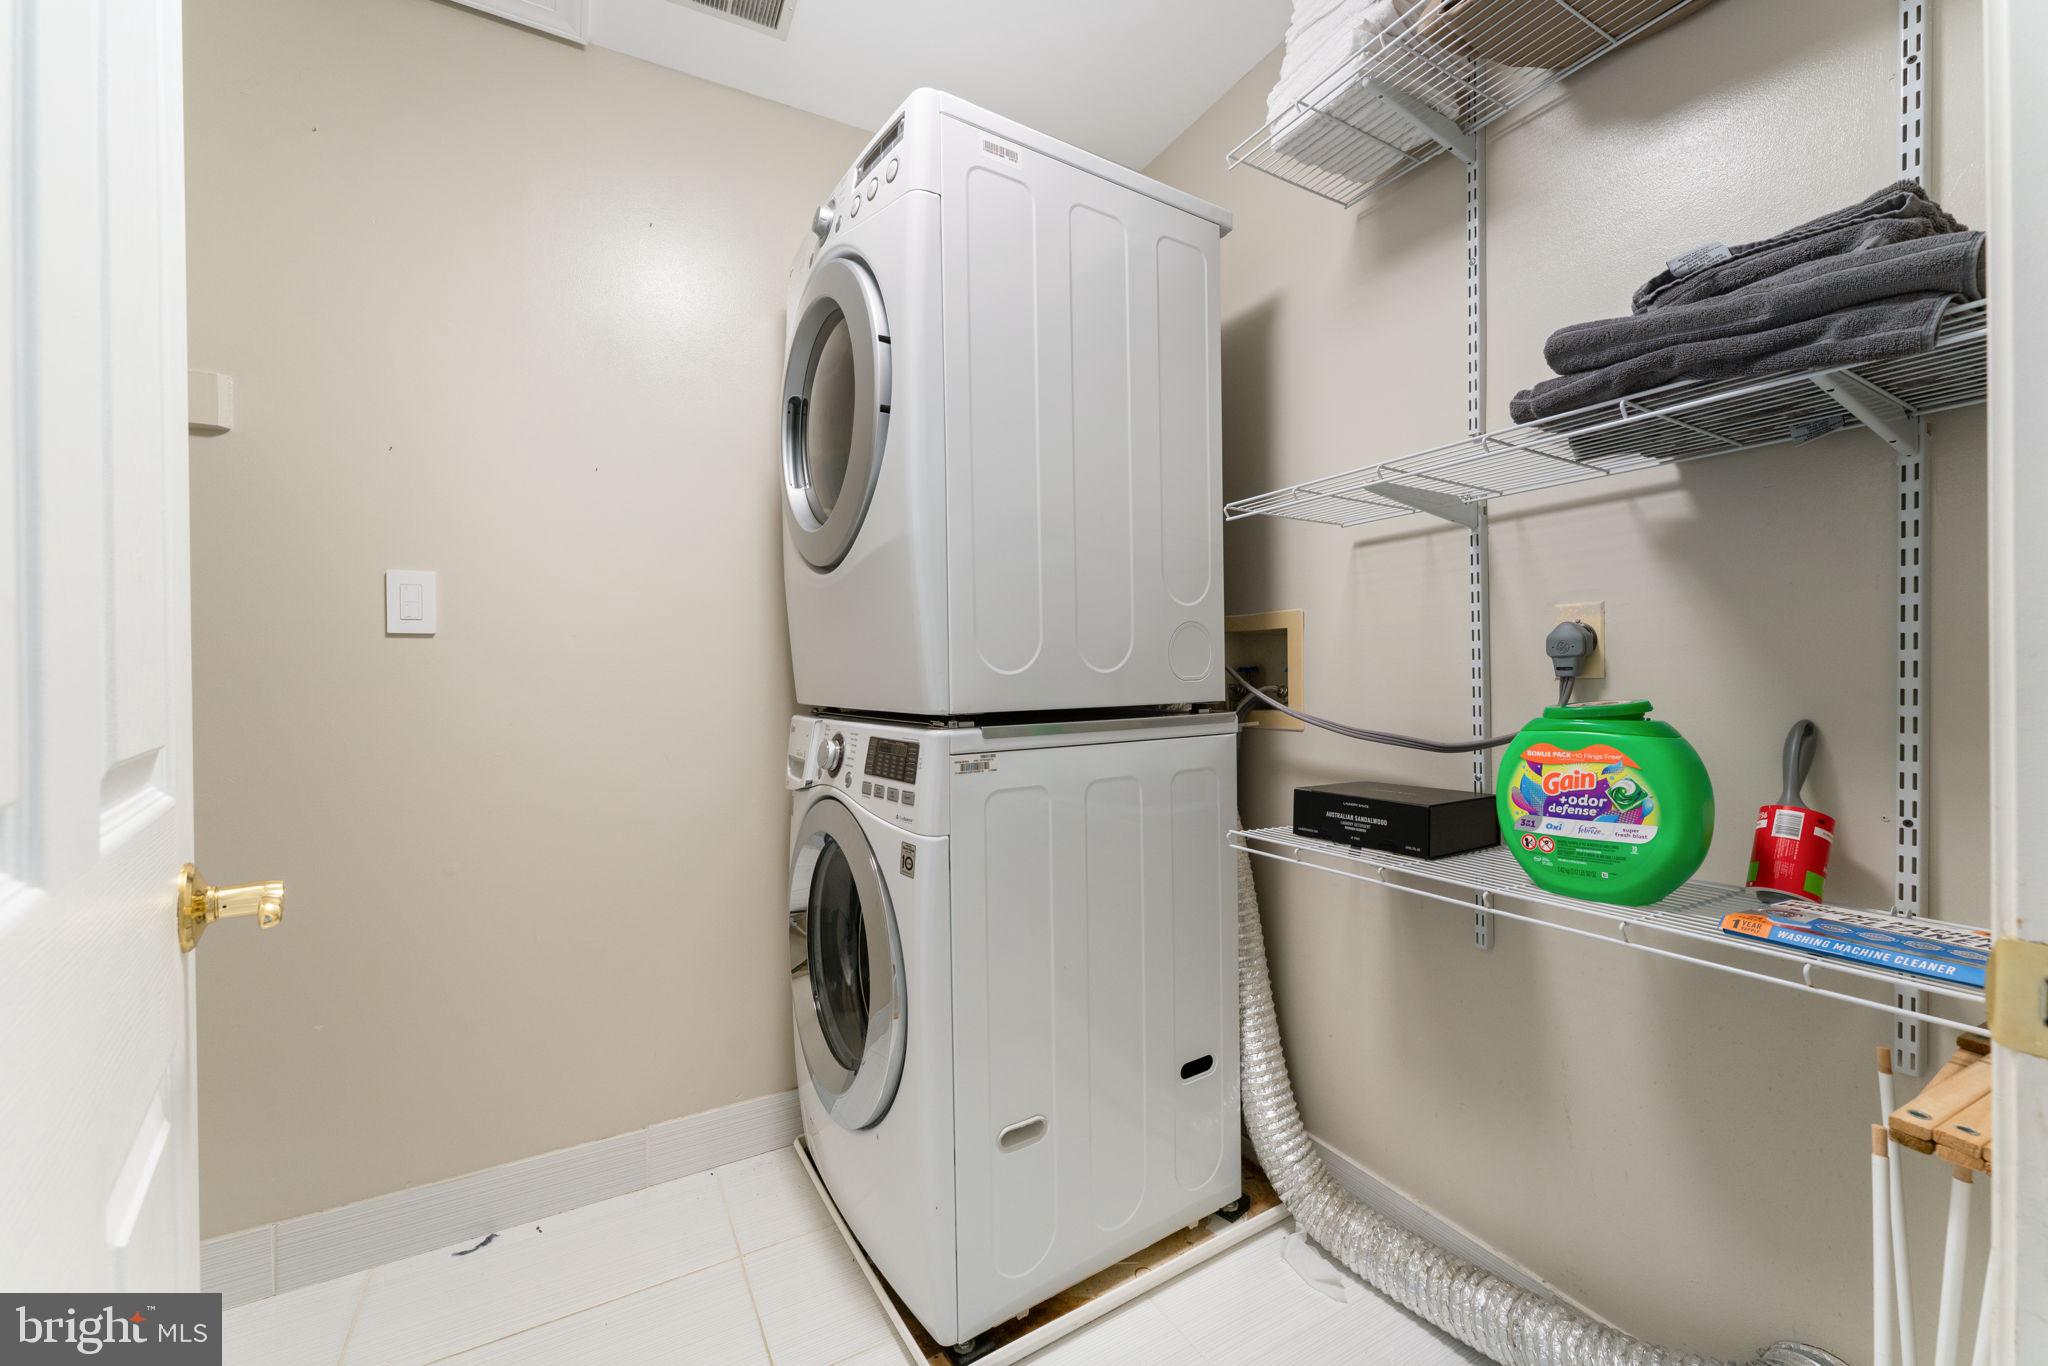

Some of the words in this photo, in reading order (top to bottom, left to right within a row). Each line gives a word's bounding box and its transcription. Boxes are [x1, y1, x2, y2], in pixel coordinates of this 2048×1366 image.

[1527, 750, 1551, 758] BONUS
[1542, 769, 1596, 796] Gain
[1559, 794, 1608, 807] +odor
[1548, 803, 1597, 816] defense
[1325, 811, 1354, 821] AUSTRALIAN
[1354, 815, 1388, 826] SANDALWOOD
[1732, 920, 1741, 929] 1
[1741, 920, 1762, 930] YEAR
[1777, 930, 1831, 948] WASHING
[1832, 942, 1892, 962] MACHINE
[1894, 955, 1957, 975] CLEANER
